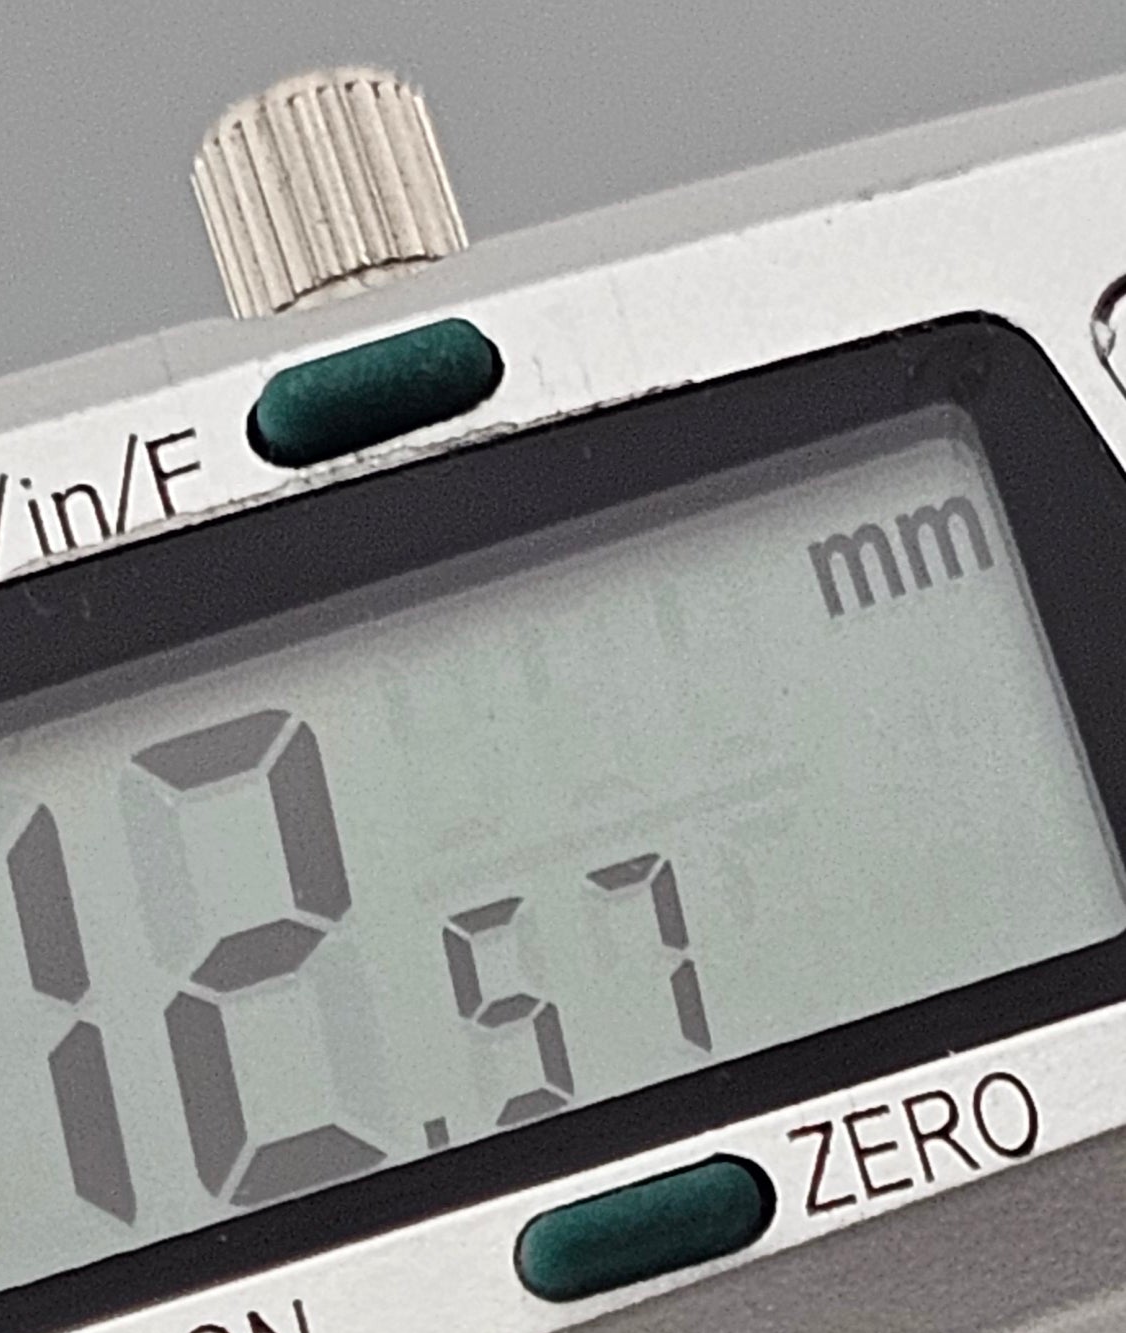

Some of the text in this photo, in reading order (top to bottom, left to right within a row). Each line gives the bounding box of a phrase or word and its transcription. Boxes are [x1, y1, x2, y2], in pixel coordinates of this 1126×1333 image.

[807, 496, 995, 619] mm
[6, 709, 712, 1226] 12.57
[789, 1070, 1038, 1218] ZERO
